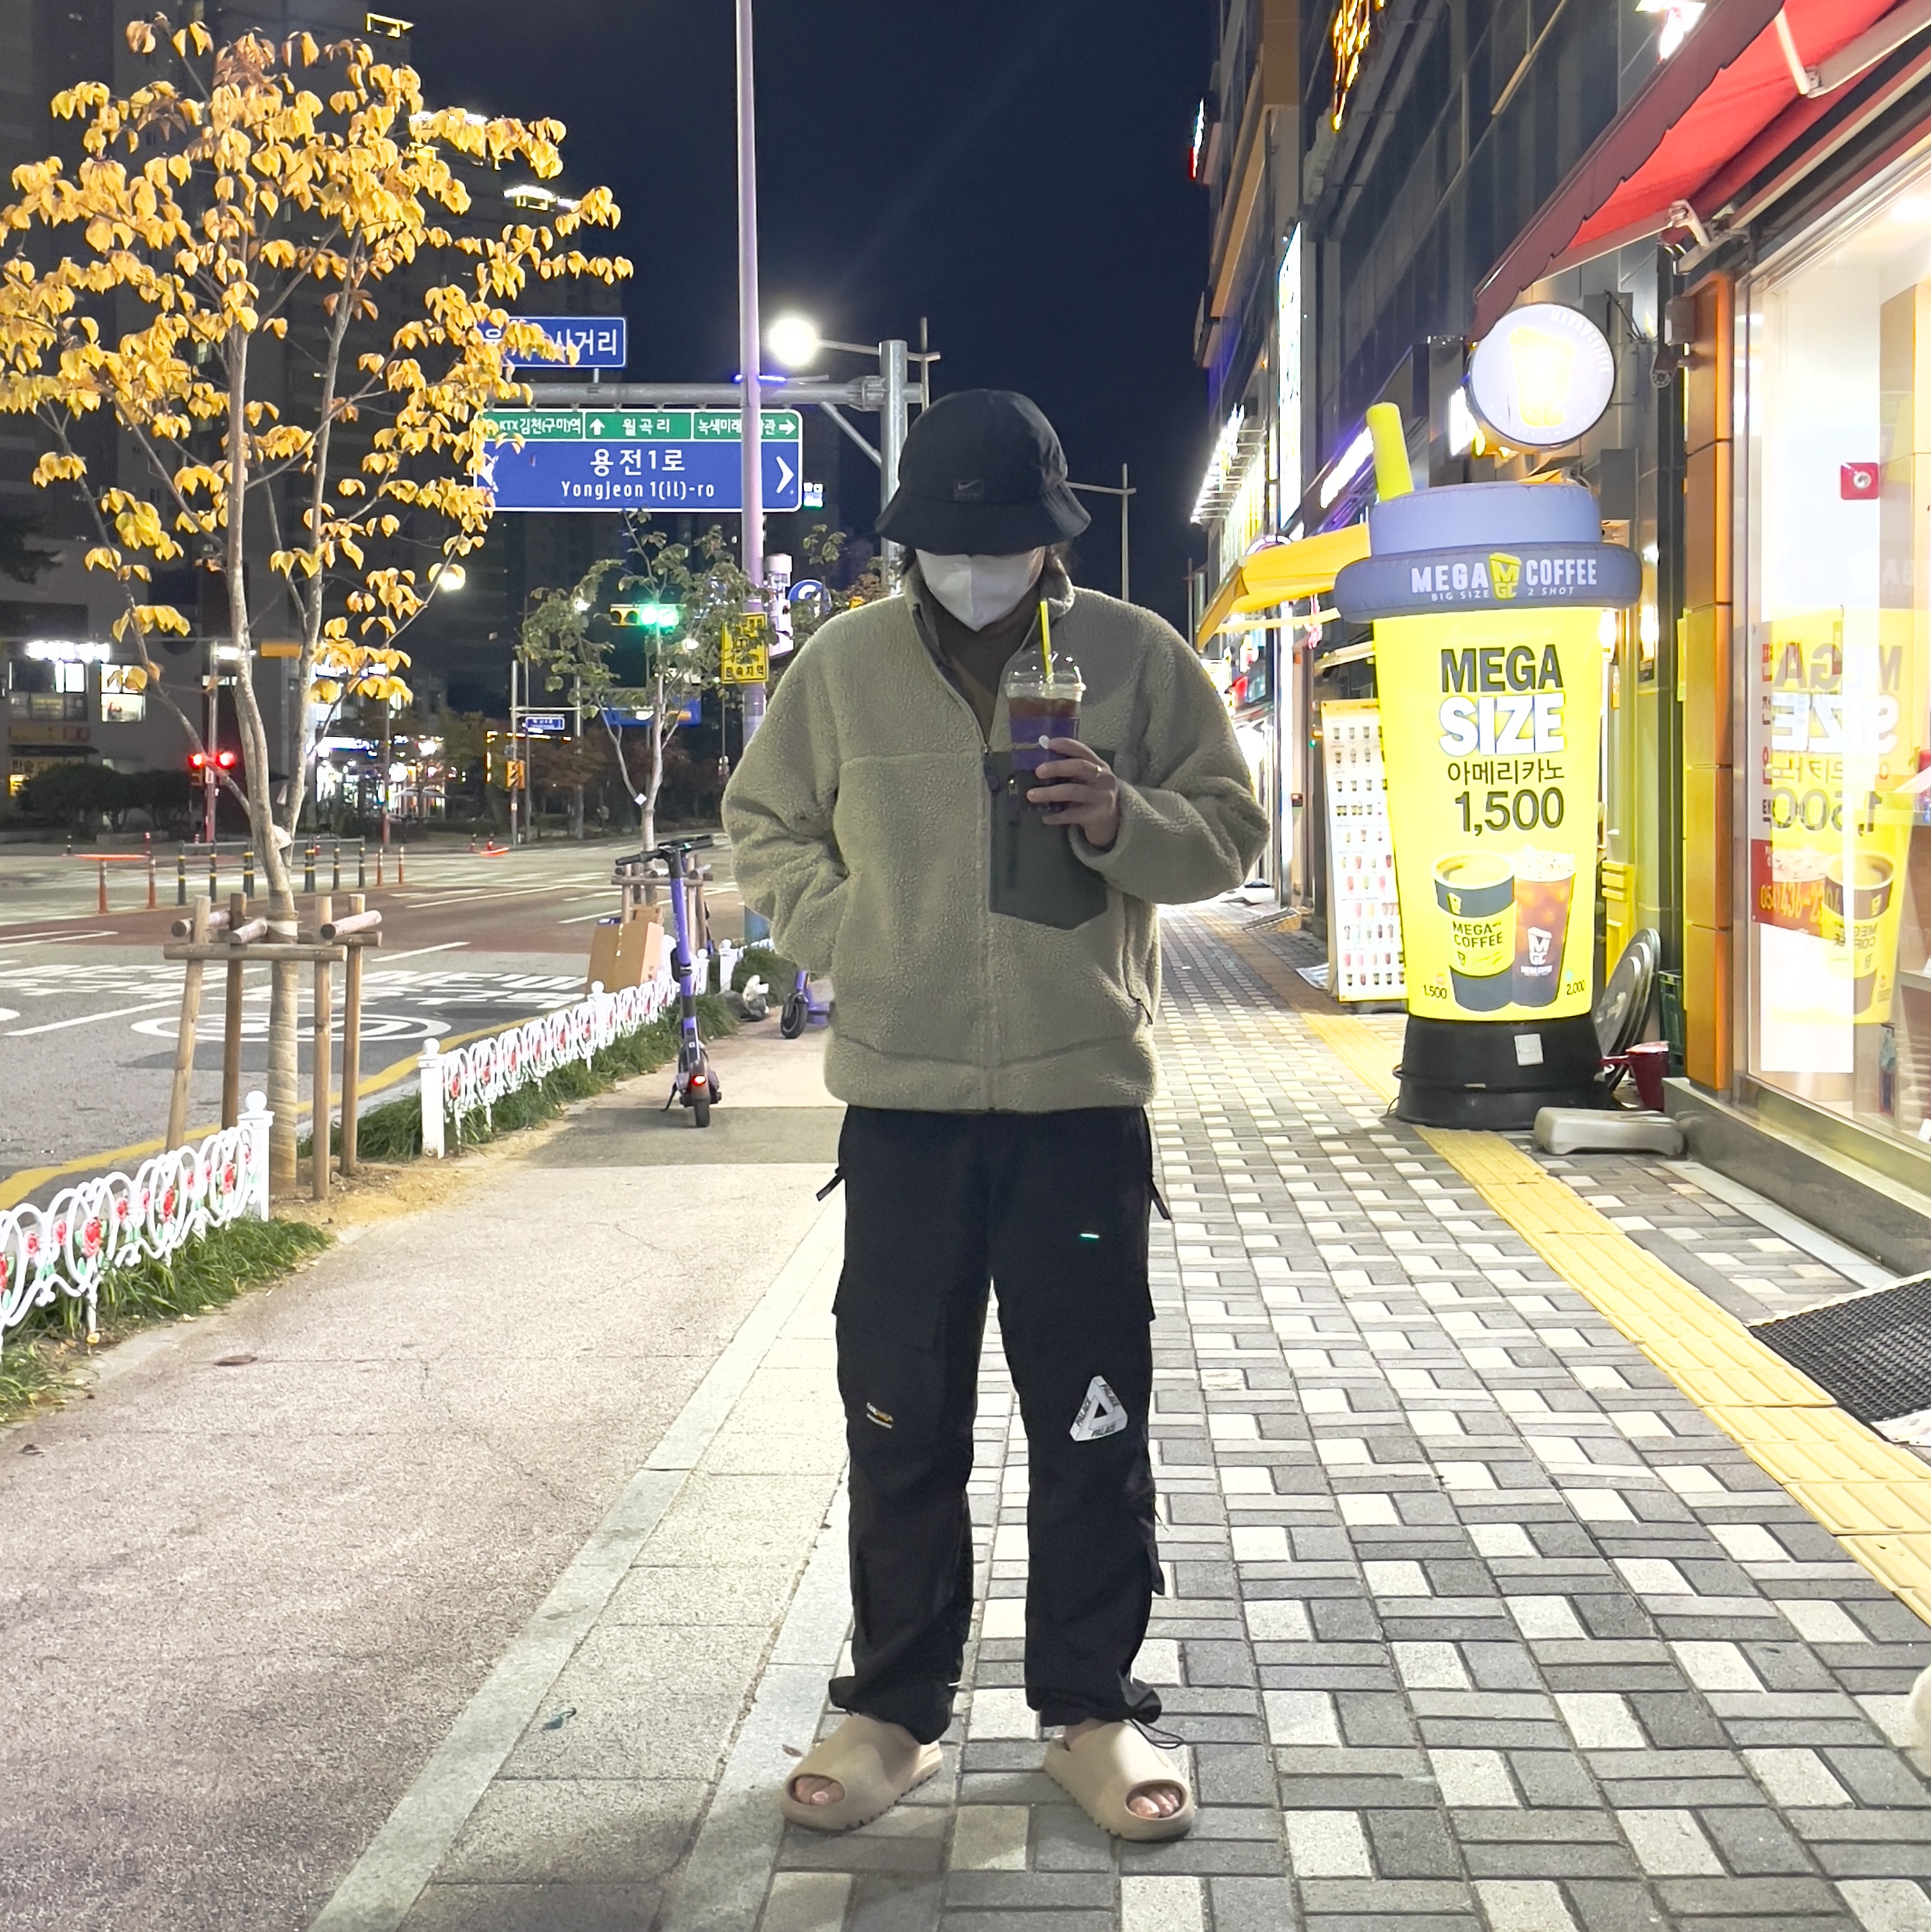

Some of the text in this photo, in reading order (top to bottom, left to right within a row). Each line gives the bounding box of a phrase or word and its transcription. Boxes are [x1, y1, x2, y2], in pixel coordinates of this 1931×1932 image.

[622, 418, 670, 436] 월곡리
[697, 418, 776, 436] 녹색미래관
[590, 448, 685, 476] 용전1로
[561, 481, 715, 500] Yongjeon 1(il)-ro
[1411, 562, 1489, 593] MEGA
[1526, 559, 1597, 586] COFFEE
[1431, 586, 1575, 602] BIG SIZE 2 SHOT
[1441, 644, 1564, 692] MEGA
[1439, 691, 1565, 757] SIZE
[1447, 758, 1564, 786] 아메리카노
[1455, 786, 1564, 837] 1,500
[1452, 921, 1493, 936] MEGA
[1454, 932, 1503, 948] COFFEE
